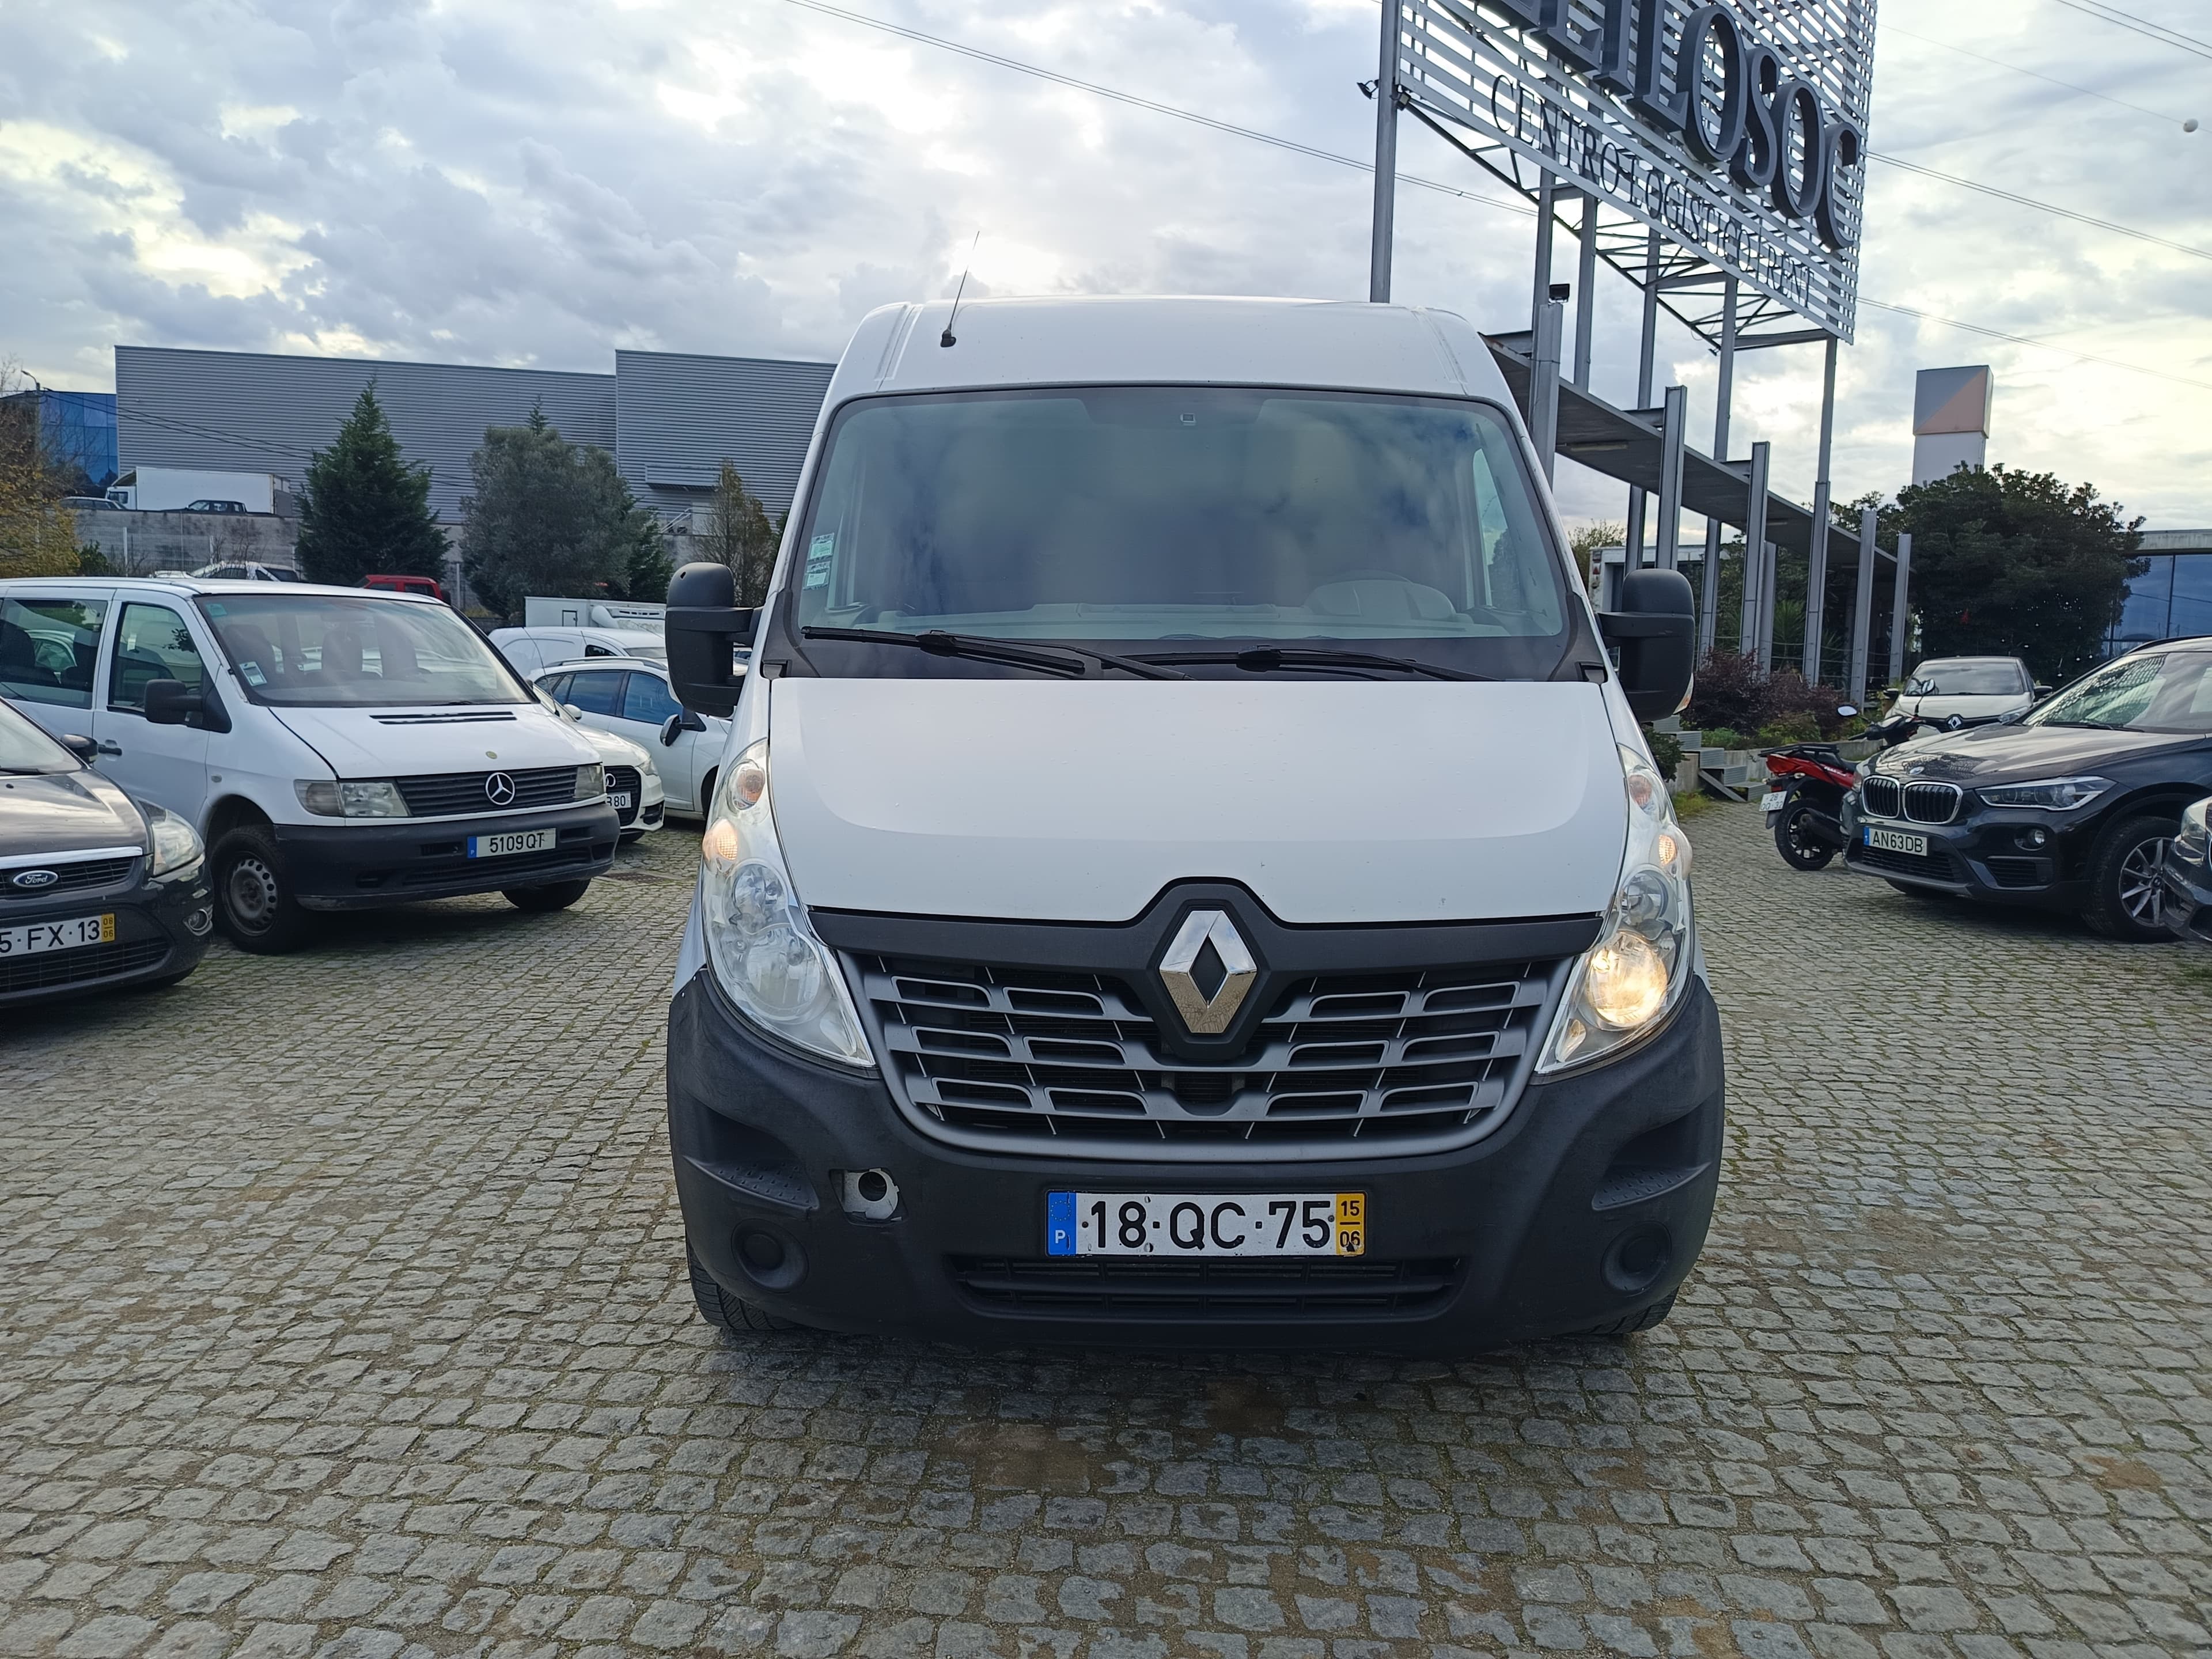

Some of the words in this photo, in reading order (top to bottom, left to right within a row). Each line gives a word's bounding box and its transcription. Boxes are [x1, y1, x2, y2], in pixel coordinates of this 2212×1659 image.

[1486, 0, 1861, 250] ILOSOC
[1491, 74, 1620, 194] CENTRO
[1340, 1200, 1360, 1217] 15
[1055, 1230, 1066, 1244] P
[1339, 1230, 1361, 1249] 06
